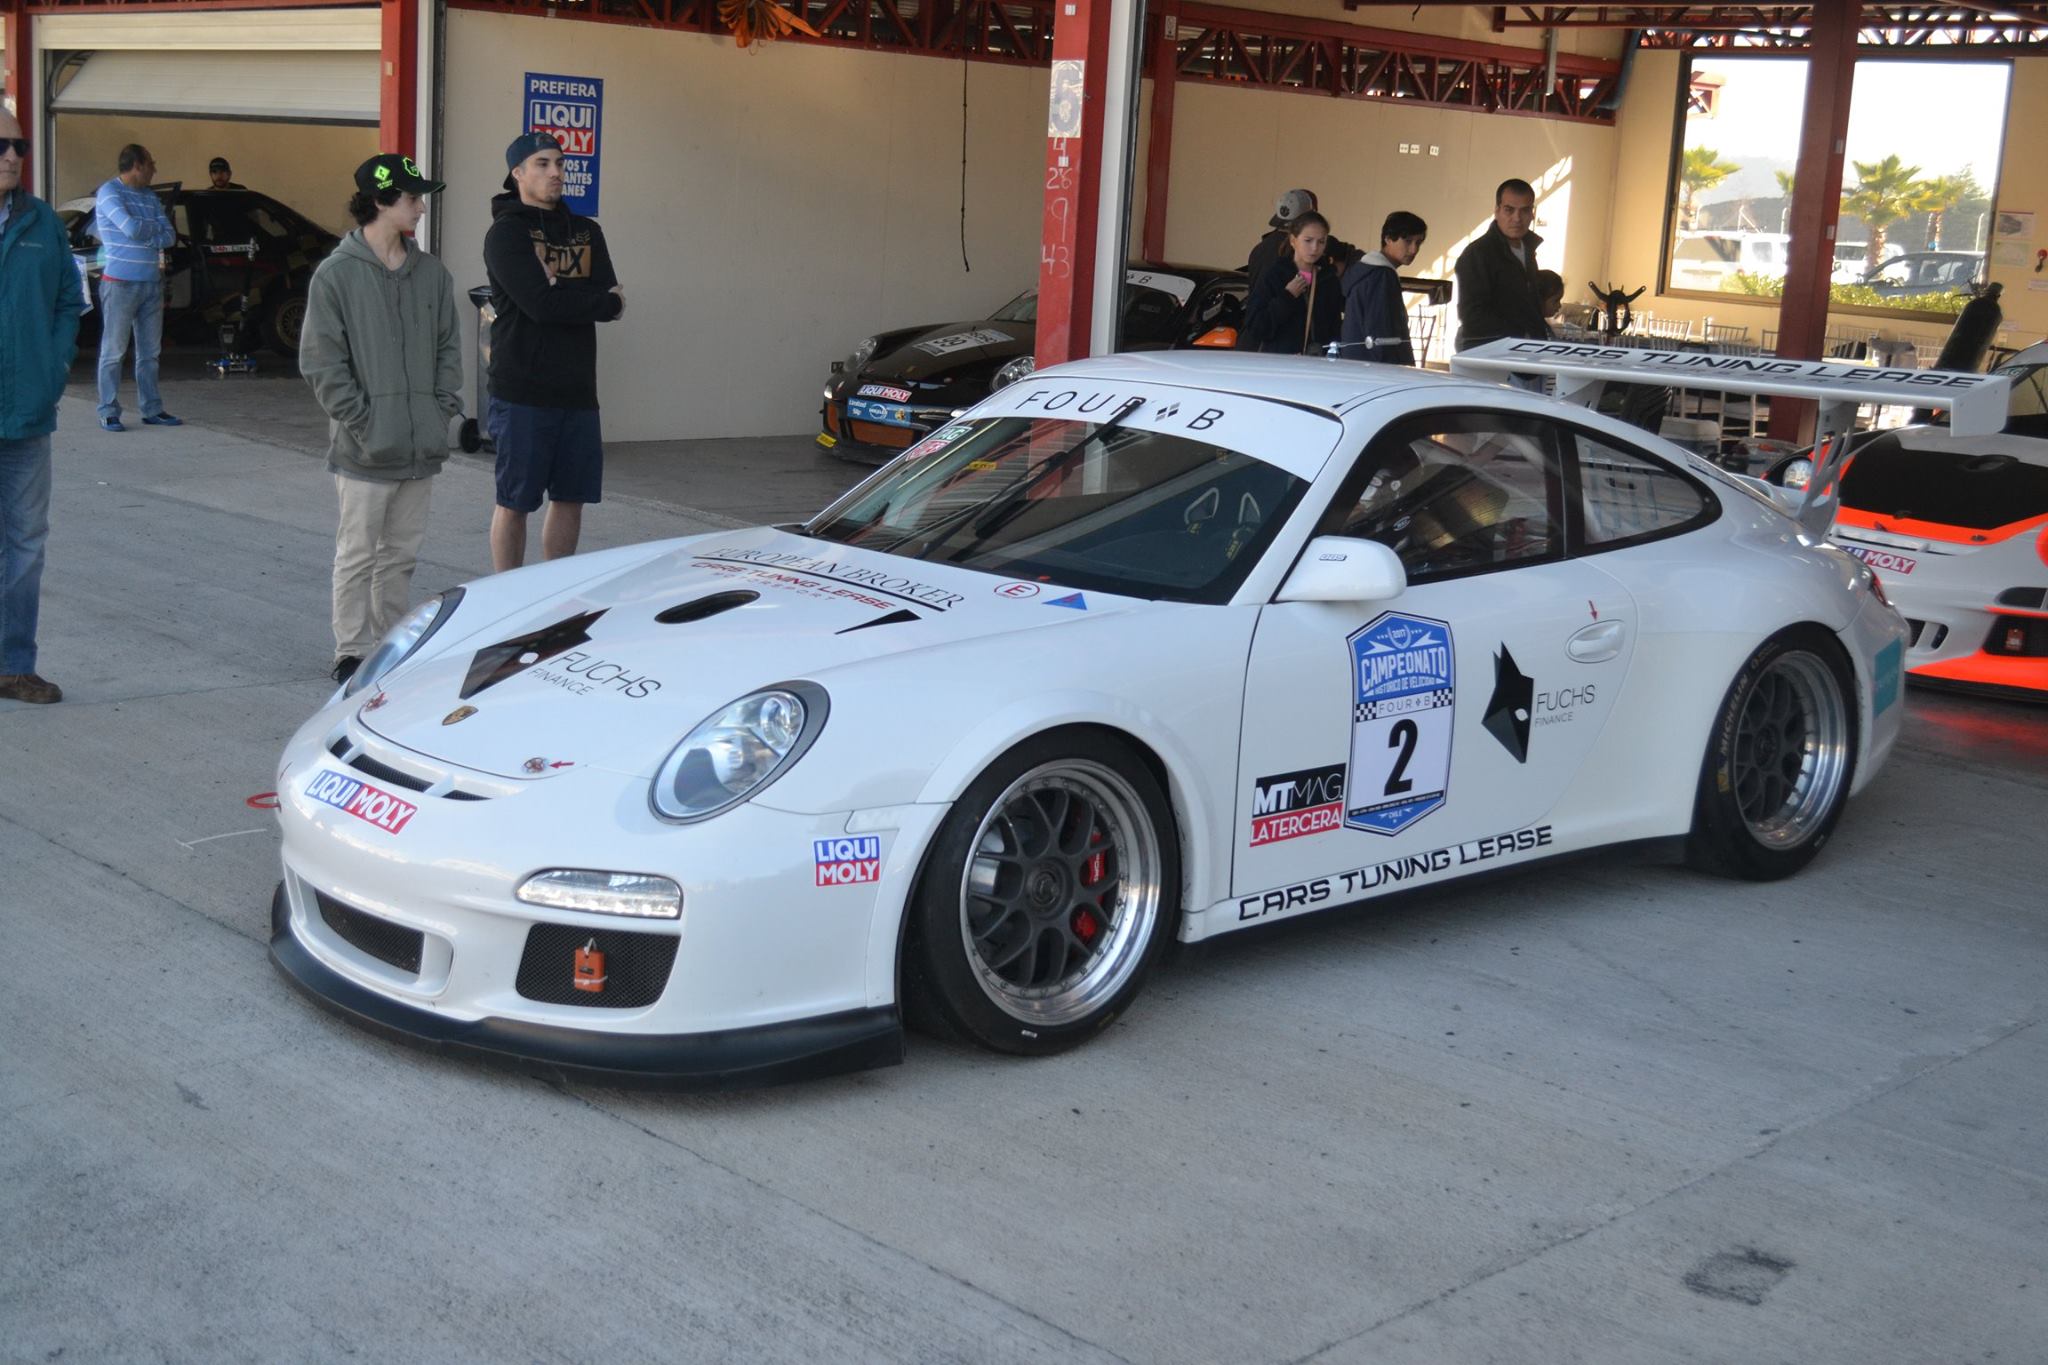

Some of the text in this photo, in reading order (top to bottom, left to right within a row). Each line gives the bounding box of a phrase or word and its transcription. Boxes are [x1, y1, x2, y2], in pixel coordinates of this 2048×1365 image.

[531, 80, 597, 98] PREFIERA
[534, 104, 592, 128] LIQUI
[534, 129, 592, 152] OLY
[581, 161, 589, 172] Y
[1051, 197, 1069, 242] 9
[545, 247, 585, 275] FOX
[1041, 244, 1071, 279] 43
[1509, 342, 1629, 360] CARS
[1641, 353, 1802, 375] TUNING
[1808, 365, 1985, 389] LEASE
[882, 388, 908, 401] MOLY
[1015, 391, 1225, 430] FOUR B
[1863, 551, 1914, 572] MOLY
[691, 562, 896, 610] CARS TUNING LEASE
[704, 548, 965, 609] EUROPEAN BROKER
[527, 667, 595, 696] FINANCE
[548, 651, 662, 699] FUCHS
[1361, 646, 1447, 692] CAMPEONATO
[1378, 695, 1431, 714] FOUR B
[1536, 684, 1596, 713] FUCHS
[1721, 674, 1749, 754] MICHELIN
[1535, 712, 1574, 728] FINANCE
[1384, 718, 1419, 797] 2
[307, 771, 415, 830] LIQUI MOLY
[1251, 807, 1341, 844] LATERCERA
[816, 838, 877, 861] LIQUI
[819, 861, 879, 885] MOLY
[1239, 825, 1552, 921] CARS TUNING LEASE
